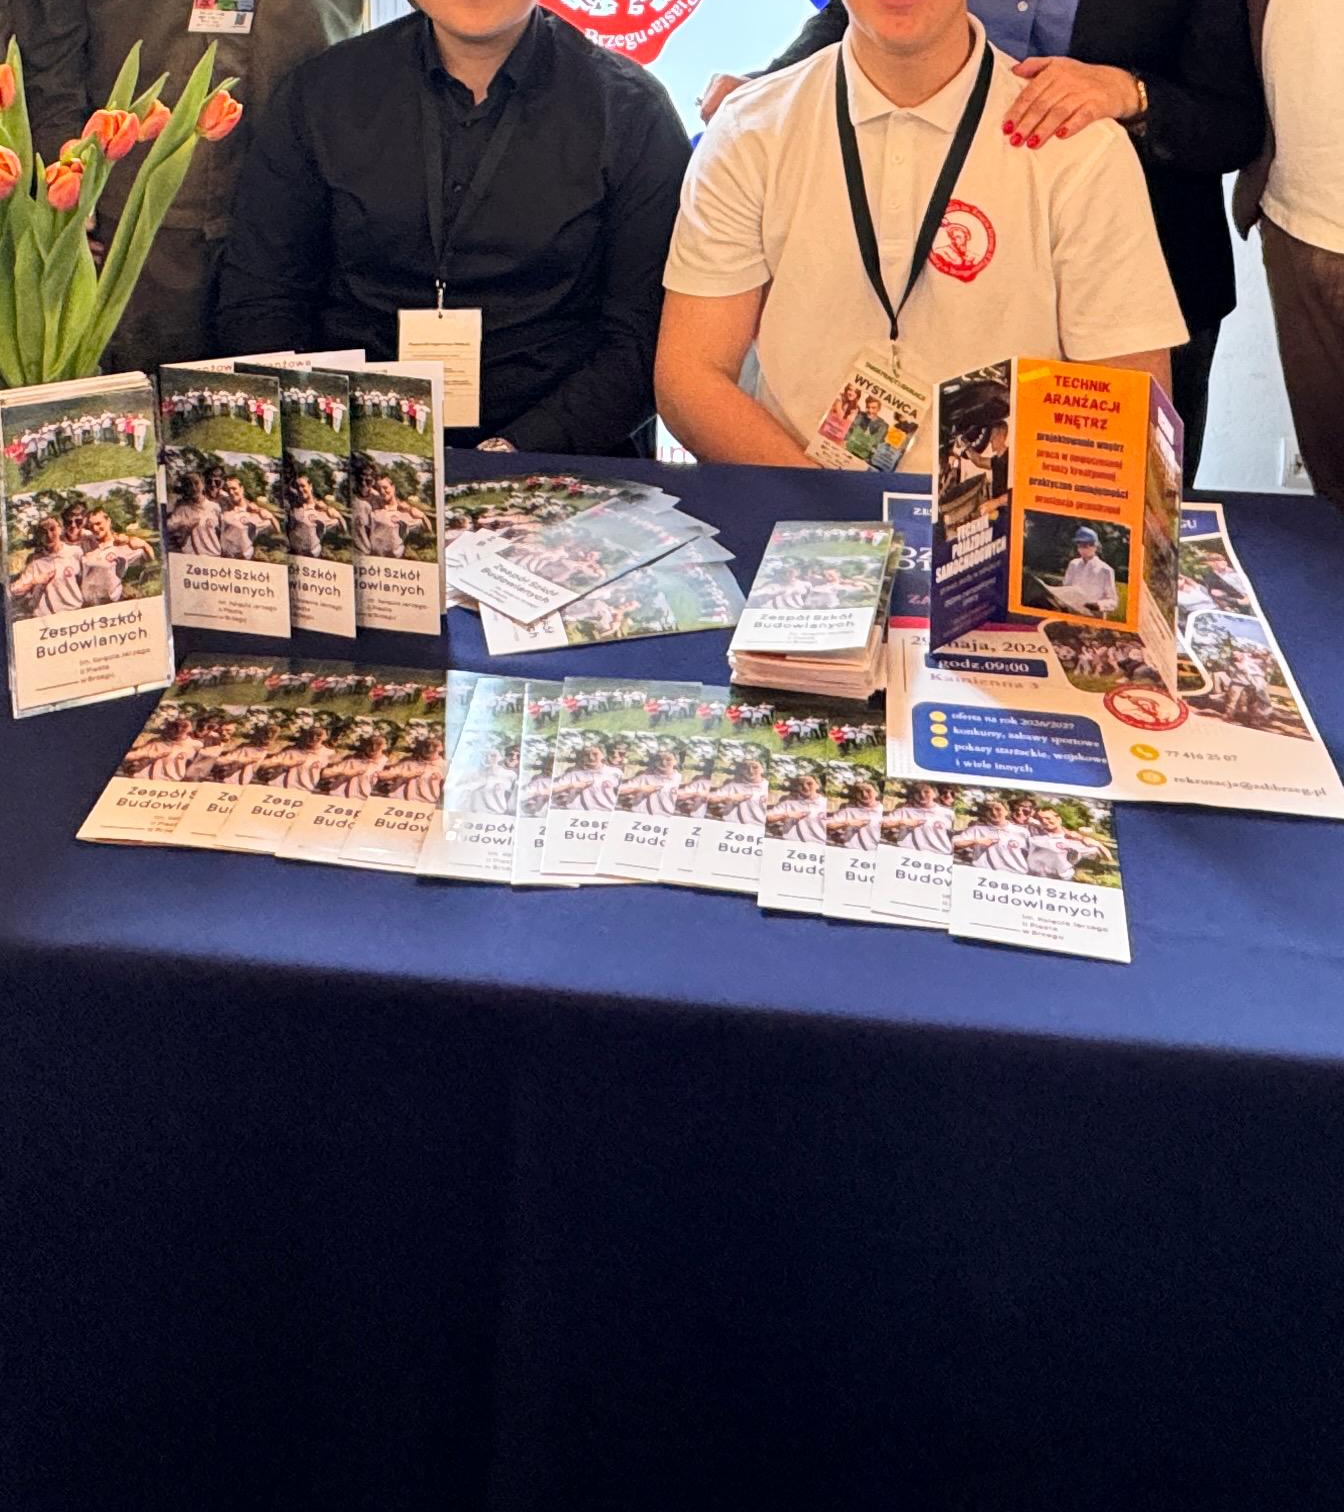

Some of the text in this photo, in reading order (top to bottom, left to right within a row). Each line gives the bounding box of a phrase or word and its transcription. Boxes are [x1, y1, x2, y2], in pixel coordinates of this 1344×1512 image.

[1054, 375, 1111, 393] TECHNIK
[854, 374, 918, 420] WYSTAWCA
[1043, 392, 1121, 414] ARANŻACJI
[1053, 412, 1108, 430] WNĘTRZ
[186, 564, 270, 584] Zespół Szkół
[302, 566, 337, 582] Szkół
[384, 566, 421, 582] Szkół
[183, 578, 275, 599] Budowlanych
[39, 609, 143, 641] Zespół Szkół
[35, 627, 148, 659] Budowlanych
[1002, 641, 1049, 654] 2026
[984, 714, 997, 724] na
[127, 785, 187, 800] Zespół
[977, 876, 1098, 904] Zespół Szkół
[972, 889, 1105, 919] Budowlanych
